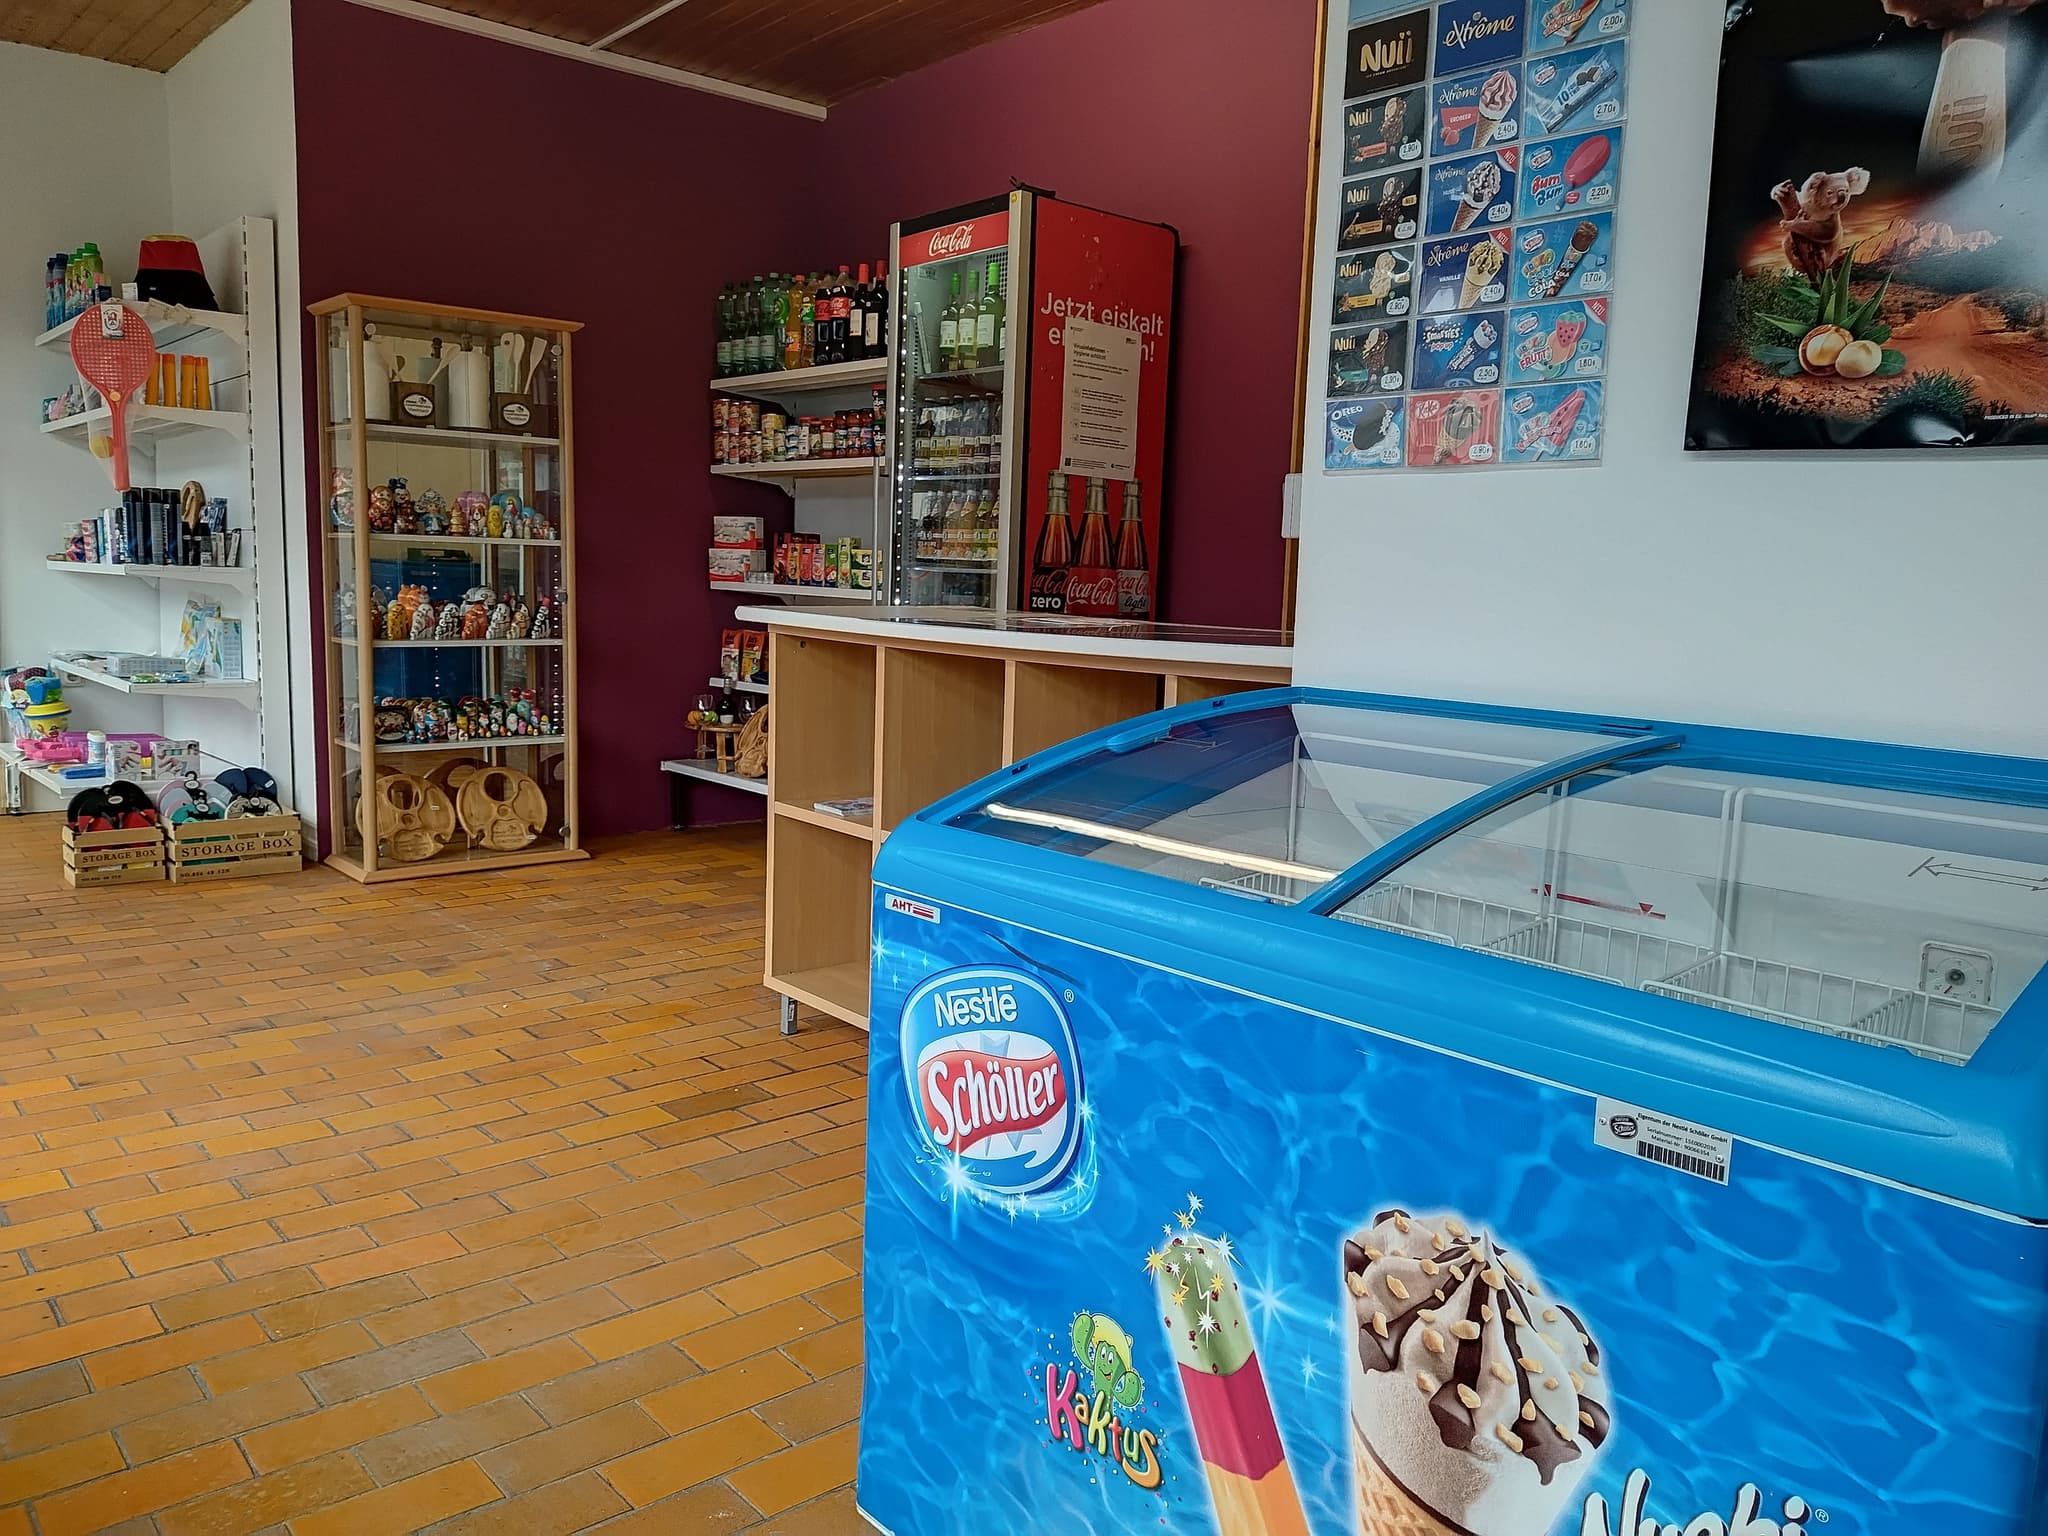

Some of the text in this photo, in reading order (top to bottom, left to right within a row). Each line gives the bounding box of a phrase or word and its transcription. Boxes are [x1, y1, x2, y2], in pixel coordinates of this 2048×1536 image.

[1360, 30, 1413, 72] Nuii
[929, 224, 975, 257] Coca-Cola
[1528, 279, 1556, 298] COLA
[1041, 292, 1164, 336] Jetzt eiskalt
[1331, 405, 1363, 420] OREO
[1032, 597, 1061, 608] zero
[1067, 576, 1118, 605] Coca-Cola
[82, 848, 157, 863] STORAGE BOX
[181, 837, 294, 858] STORAGE BOX
[891, 898, 913, 913] AHT
[927, 1059, 1058, 1145] Schöller
[1637, 1112, 1662, 1124] Eigentum
[1689, 1127, 1710, 1139] Schöller
[1710, 1134, 1728, 1144] GmbH
[1047, 1363, 1161, 1488] Kaktus
